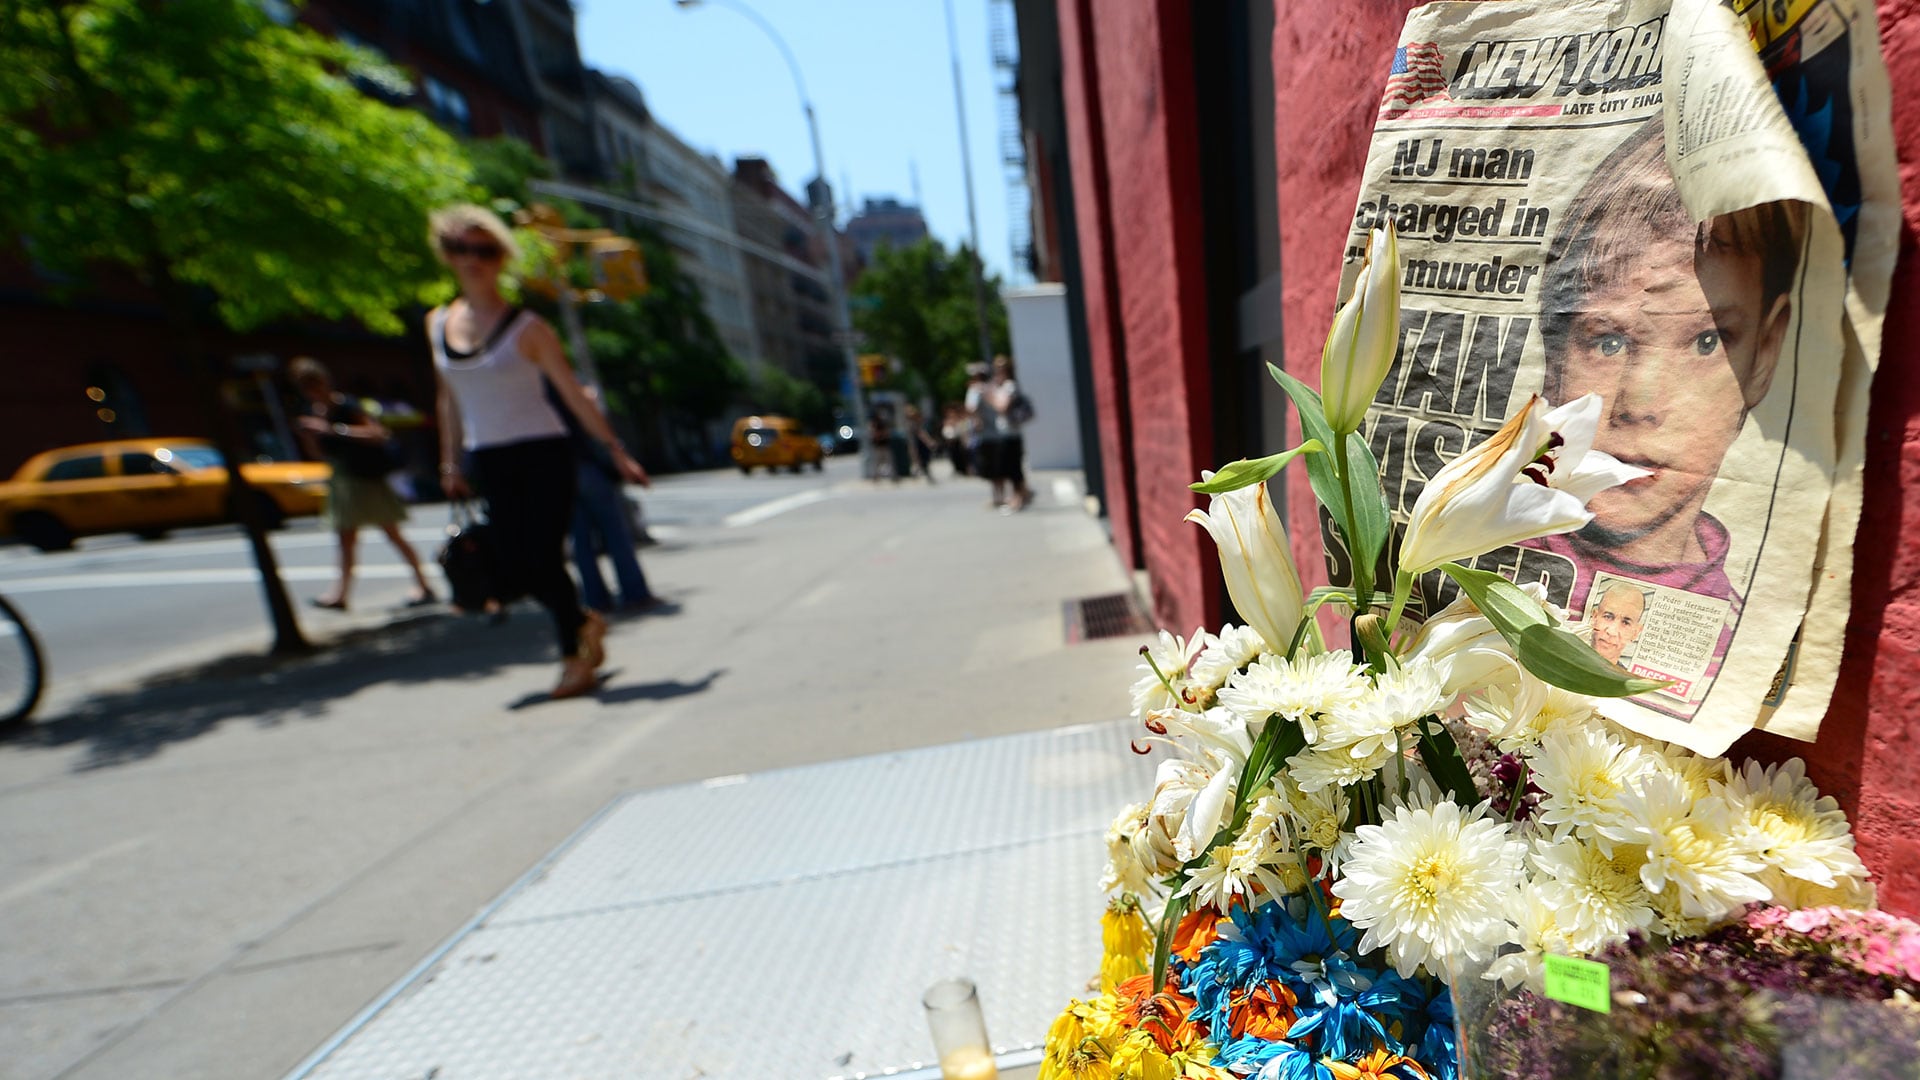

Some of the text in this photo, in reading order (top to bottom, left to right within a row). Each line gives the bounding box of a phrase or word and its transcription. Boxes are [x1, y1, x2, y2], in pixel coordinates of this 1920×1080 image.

[1451, 38, 1567, 97] NEW
[1562, 92, 1664, 116] LATE CITY FINA
[1391, 139, 1536, 180] NJ man
[1356, 194, 1551, 243] charged in
[1403, 255, 1541, 294] murder
[1338, 304, 1532, 421] TAN
[1651, 608, 1675, 620] charged
[1676, 615, 1690, 623] with
[1662, 595, 1722, 616] Pedro Hernandez
[1672, 606, 1704, 620] yesterday
